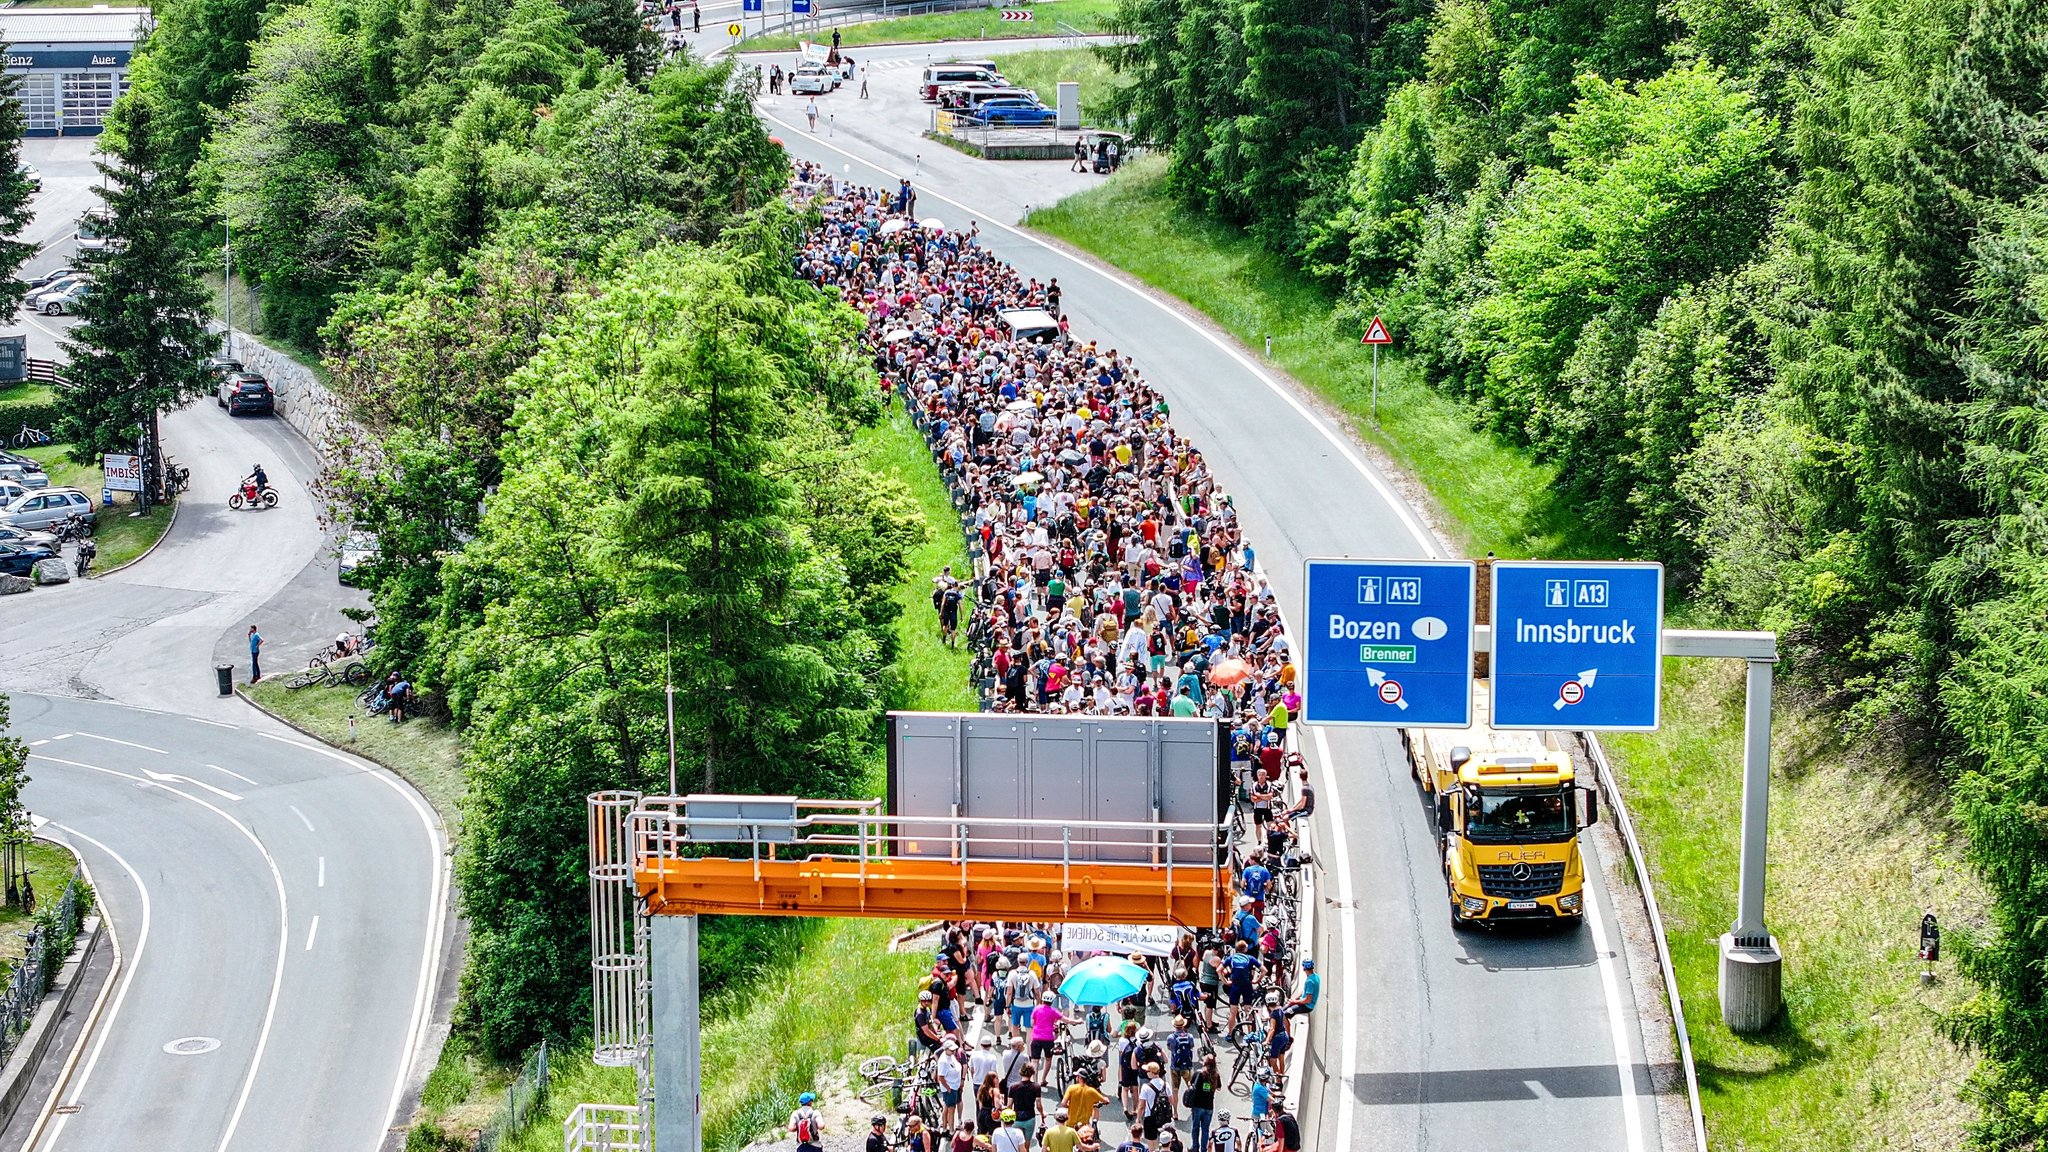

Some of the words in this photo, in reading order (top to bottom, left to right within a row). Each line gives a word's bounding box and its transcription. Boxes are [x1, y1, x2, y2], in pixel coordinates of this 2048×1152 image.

[91, 55, 116, 65] Auer
[106, 467, 140, 479] IMBISS
[1390, 581, 1417, 601] A13
[1578, 584, 1605, 604] A13
[1329, 614, 1401, 640] Bozen
[1516, 618, 1636, 644] Innsbruck
[1363, 647, 1413, 661] Brenner
